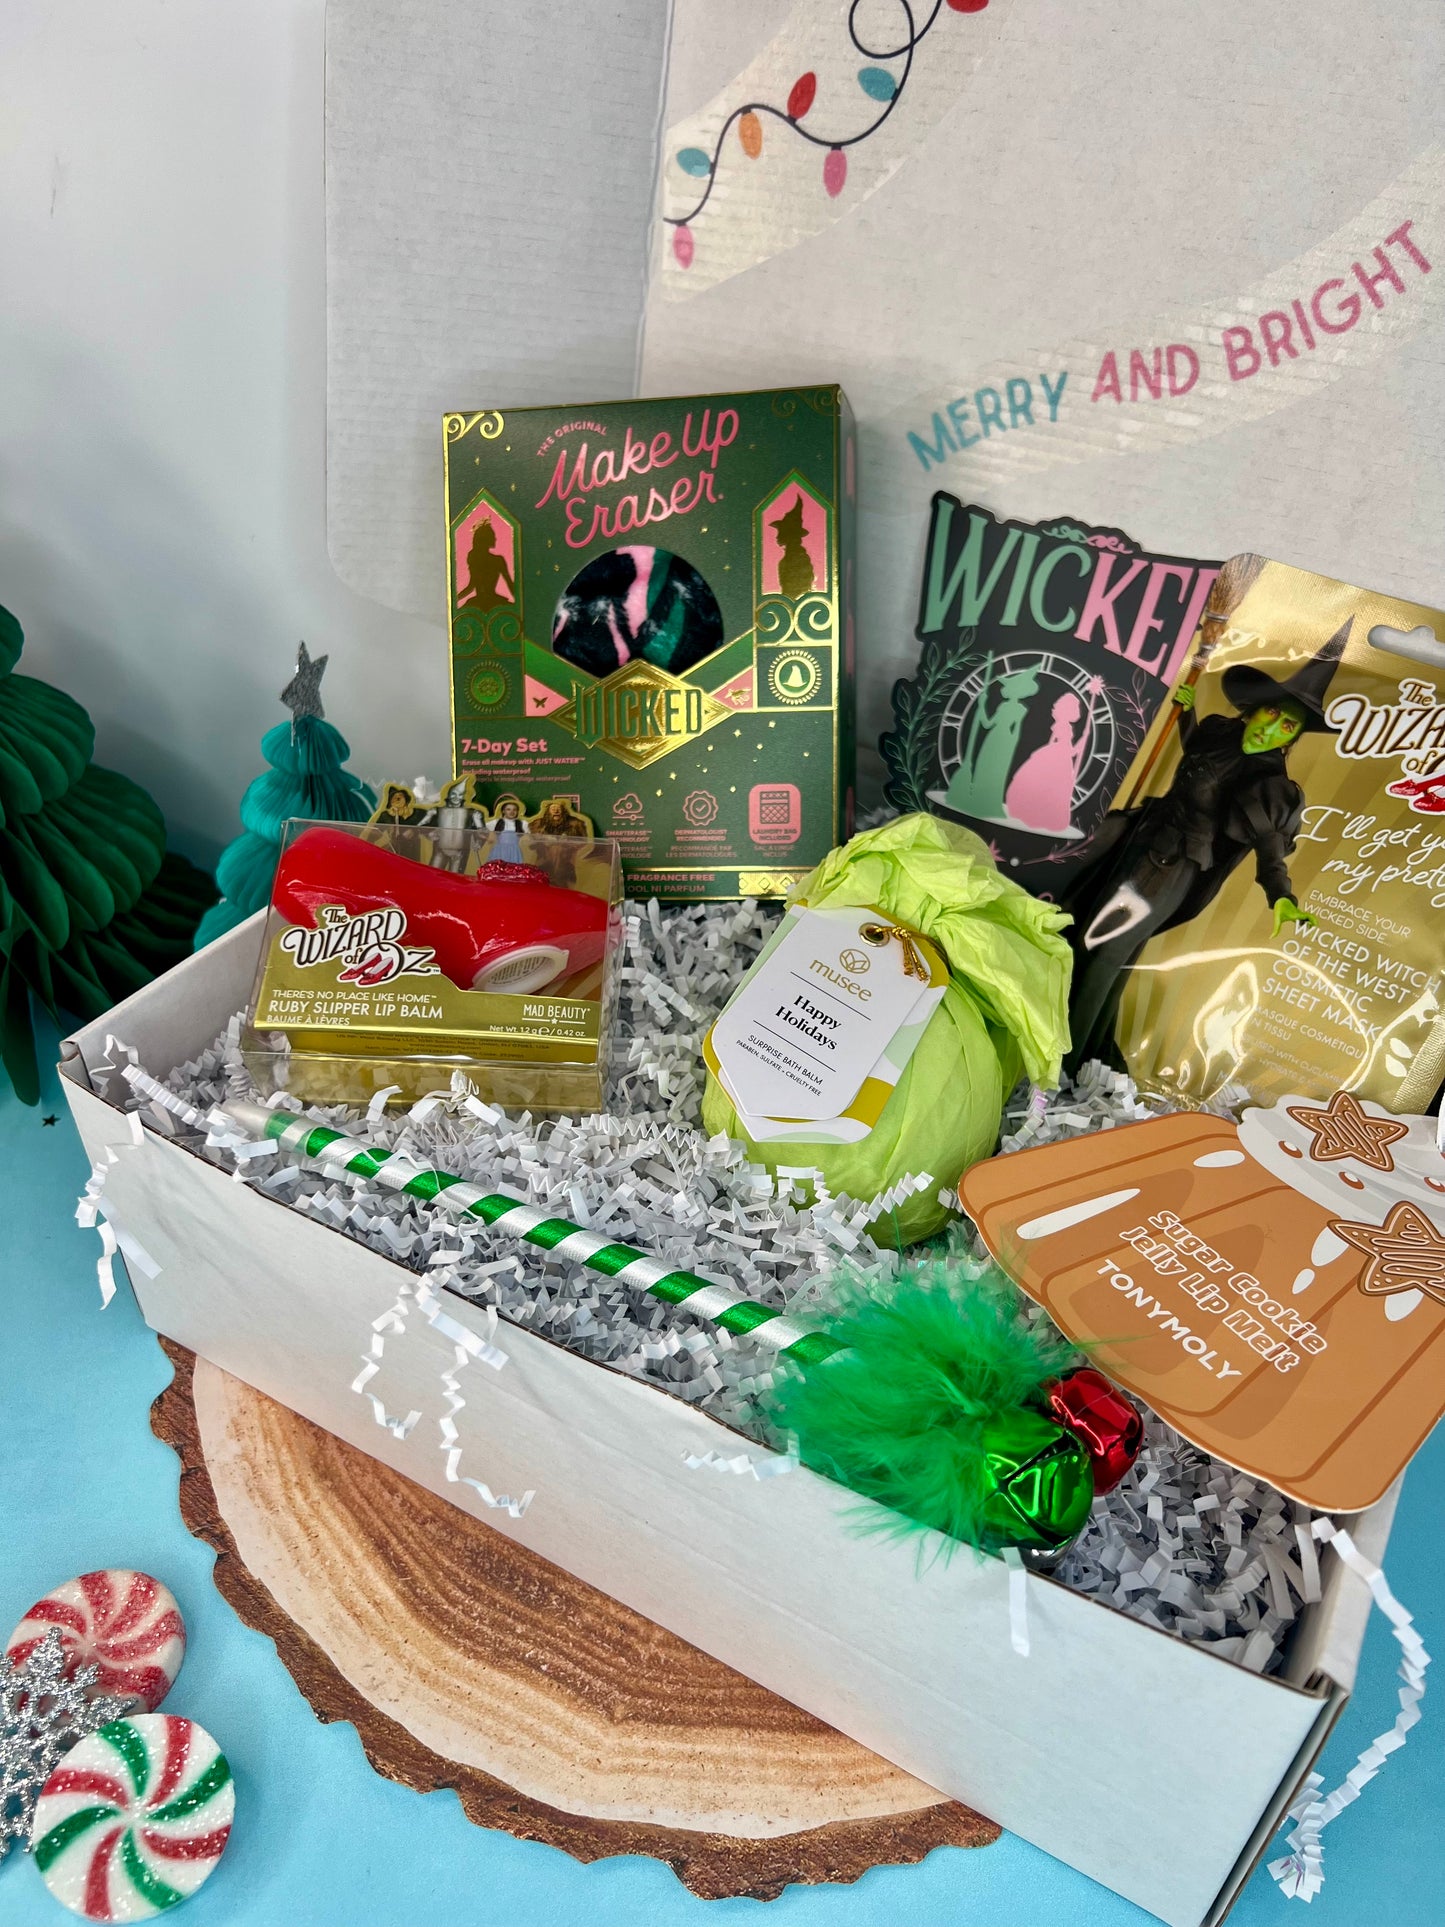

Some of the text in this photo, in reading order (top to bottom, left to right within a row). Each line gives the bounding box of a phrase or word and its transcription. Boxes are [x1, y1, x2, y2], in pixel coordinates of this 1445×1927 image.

[906, 218, 1432, 472] MERRY AND BRIGHT
[536, 420, 608, 458] THE ORIGINAL
[1403, 680, 1434, 706] The
[570, 679, 704, 749] WICKED
[461, 737, 549, 757] 7-Day Set
[482, 758, 491, 766] all
[491, 759, 517, 767] makeup
[518, 757, 534, 765] with
[535, 757, 553, 765] JUST
[1406, 750, 1436, 775] of
[493, 767, 531, 776] waterproof
[1294, 805, 1377, 842] I'll
[1358, 822, 1423, 858] get
[627, 873, 716, 882] FRAGRANCE FREE
[650, 884, 662, 892] NI
[664, 884, 706, 893] PARFUM
[1321, 857, 1376, 895] my
[326, 907, 349, 925] The
[1304, 902, 1354, 930] WICKED
[1309, 889, 1412, 938] EMBRACE YOUR
[282, 907, 406, 966] WIZARD
[344, 946, 363, 966] of
[1282, 940, 1312, 960] OF
[1314, 951, 1351, 979] THE
[1294, 919, 1442, 995] WICKED WITCH
[273, 989, 315, 999] THERE'S
[317, 990, 335, 999] NO
[337, 991, 371, 1001] PLACE
[373, 993, 396, 1002] LIKE
[809, 959, 873, 1002] musee
[1272, 959, 1373, 1013] COSMETIC
[266, 1014, 302, 1024] BAUME
[315, 1013, 351, 1027] LÈVRES
[268, 999, 444, 1020] RUBY SLIPPER LIP BALM
[523, 1003, 545, 1017] MAD
[775, 1005, 838, 1051] Holidays
[794, 994, 843, 1030] Happy
[1262, 976, 1383, 1042] SHEET MASK
[489, 1025, 504, 1033] Net
[556, 1028, 573, 1037] 0.42
[1263, 1022, 1292, 1041] TISSU
[736, 1039, 822, 1097] PARABEN, SULFATE CRUELTY FREE
[748, 1034, 823, 1086] SURPRISE BATH BALM
[1119, 1225, 1301, 1374] Jelly Lip Melt
[1147, 1209, 1327, 1356] Sugar Cookie
[1095, 1257, 1243, 1381] TONYMOLY
